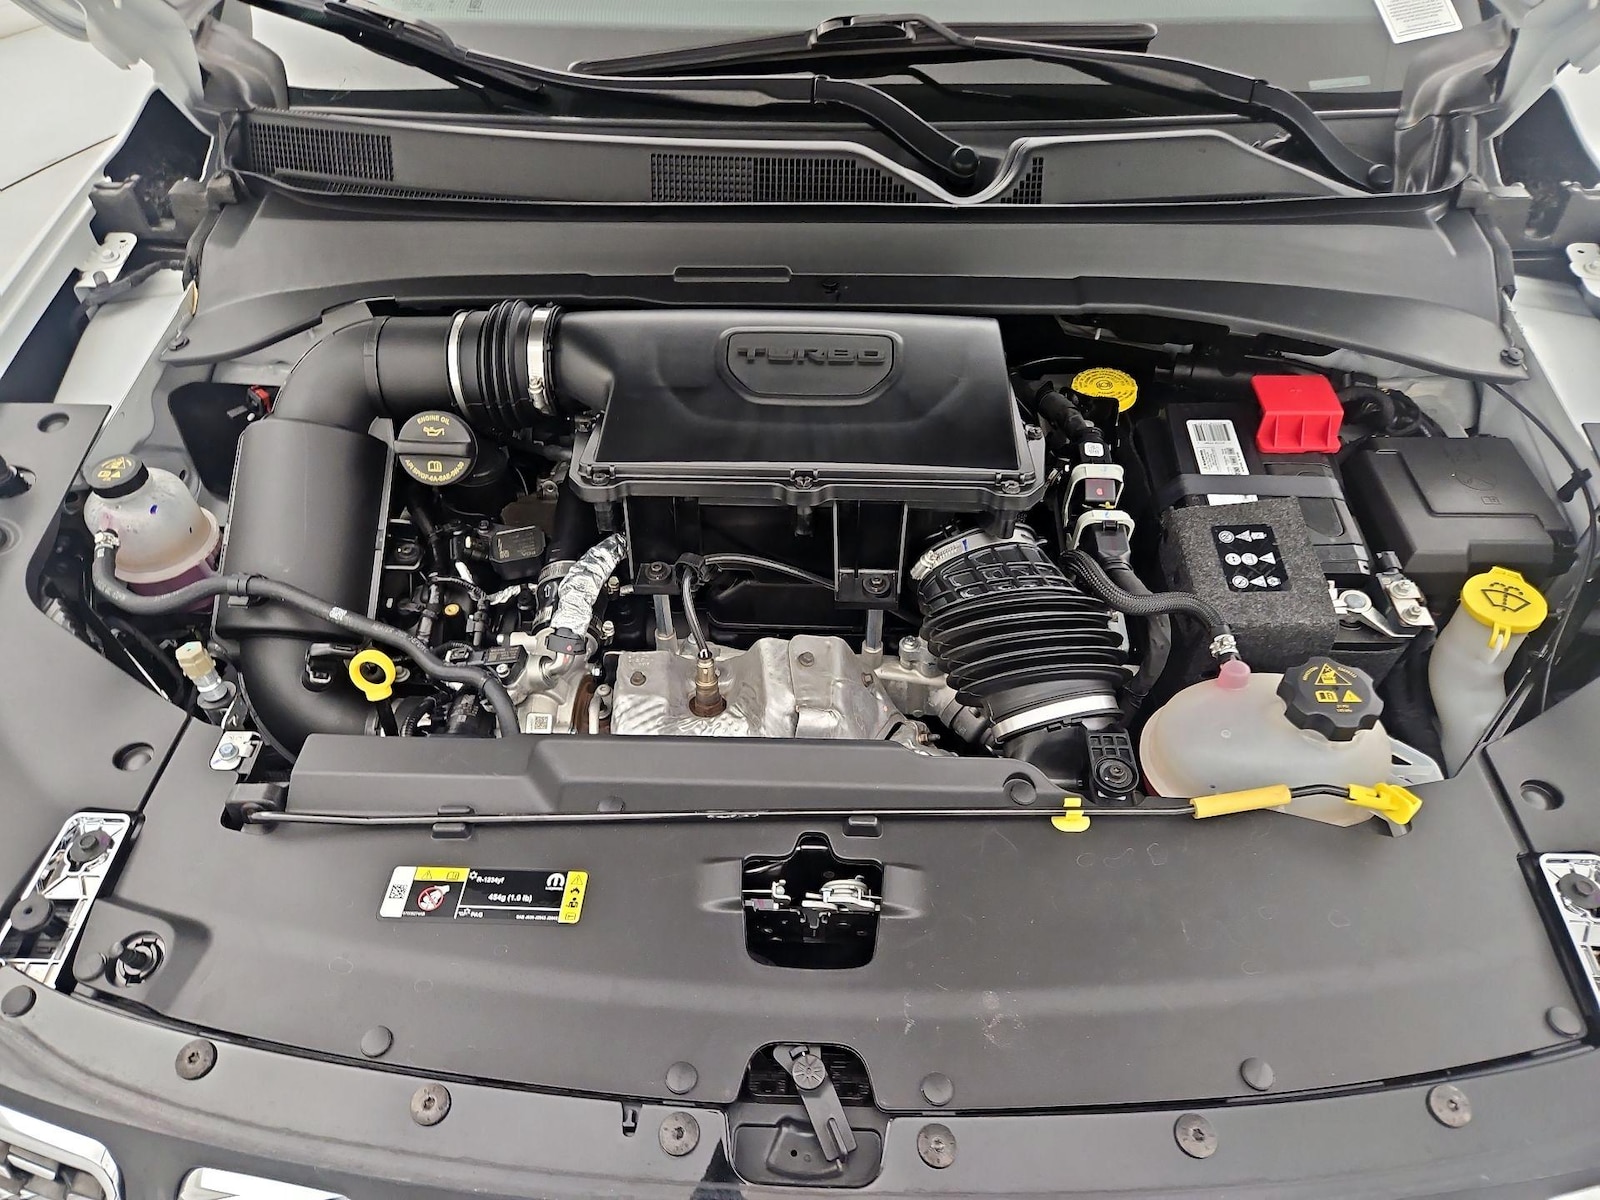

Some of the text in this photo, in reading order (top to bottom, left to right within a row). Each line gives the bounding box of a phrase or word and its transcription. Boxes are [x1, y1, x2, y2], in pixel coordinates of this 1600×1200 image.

[737, 346, 886, 364] TURBO
[417, 414, 450, 426] ENGINE OIL
[476, 876, 505, 885] R-1234yf
[488, 893, 533, 904] 454g (1.0 lb)
